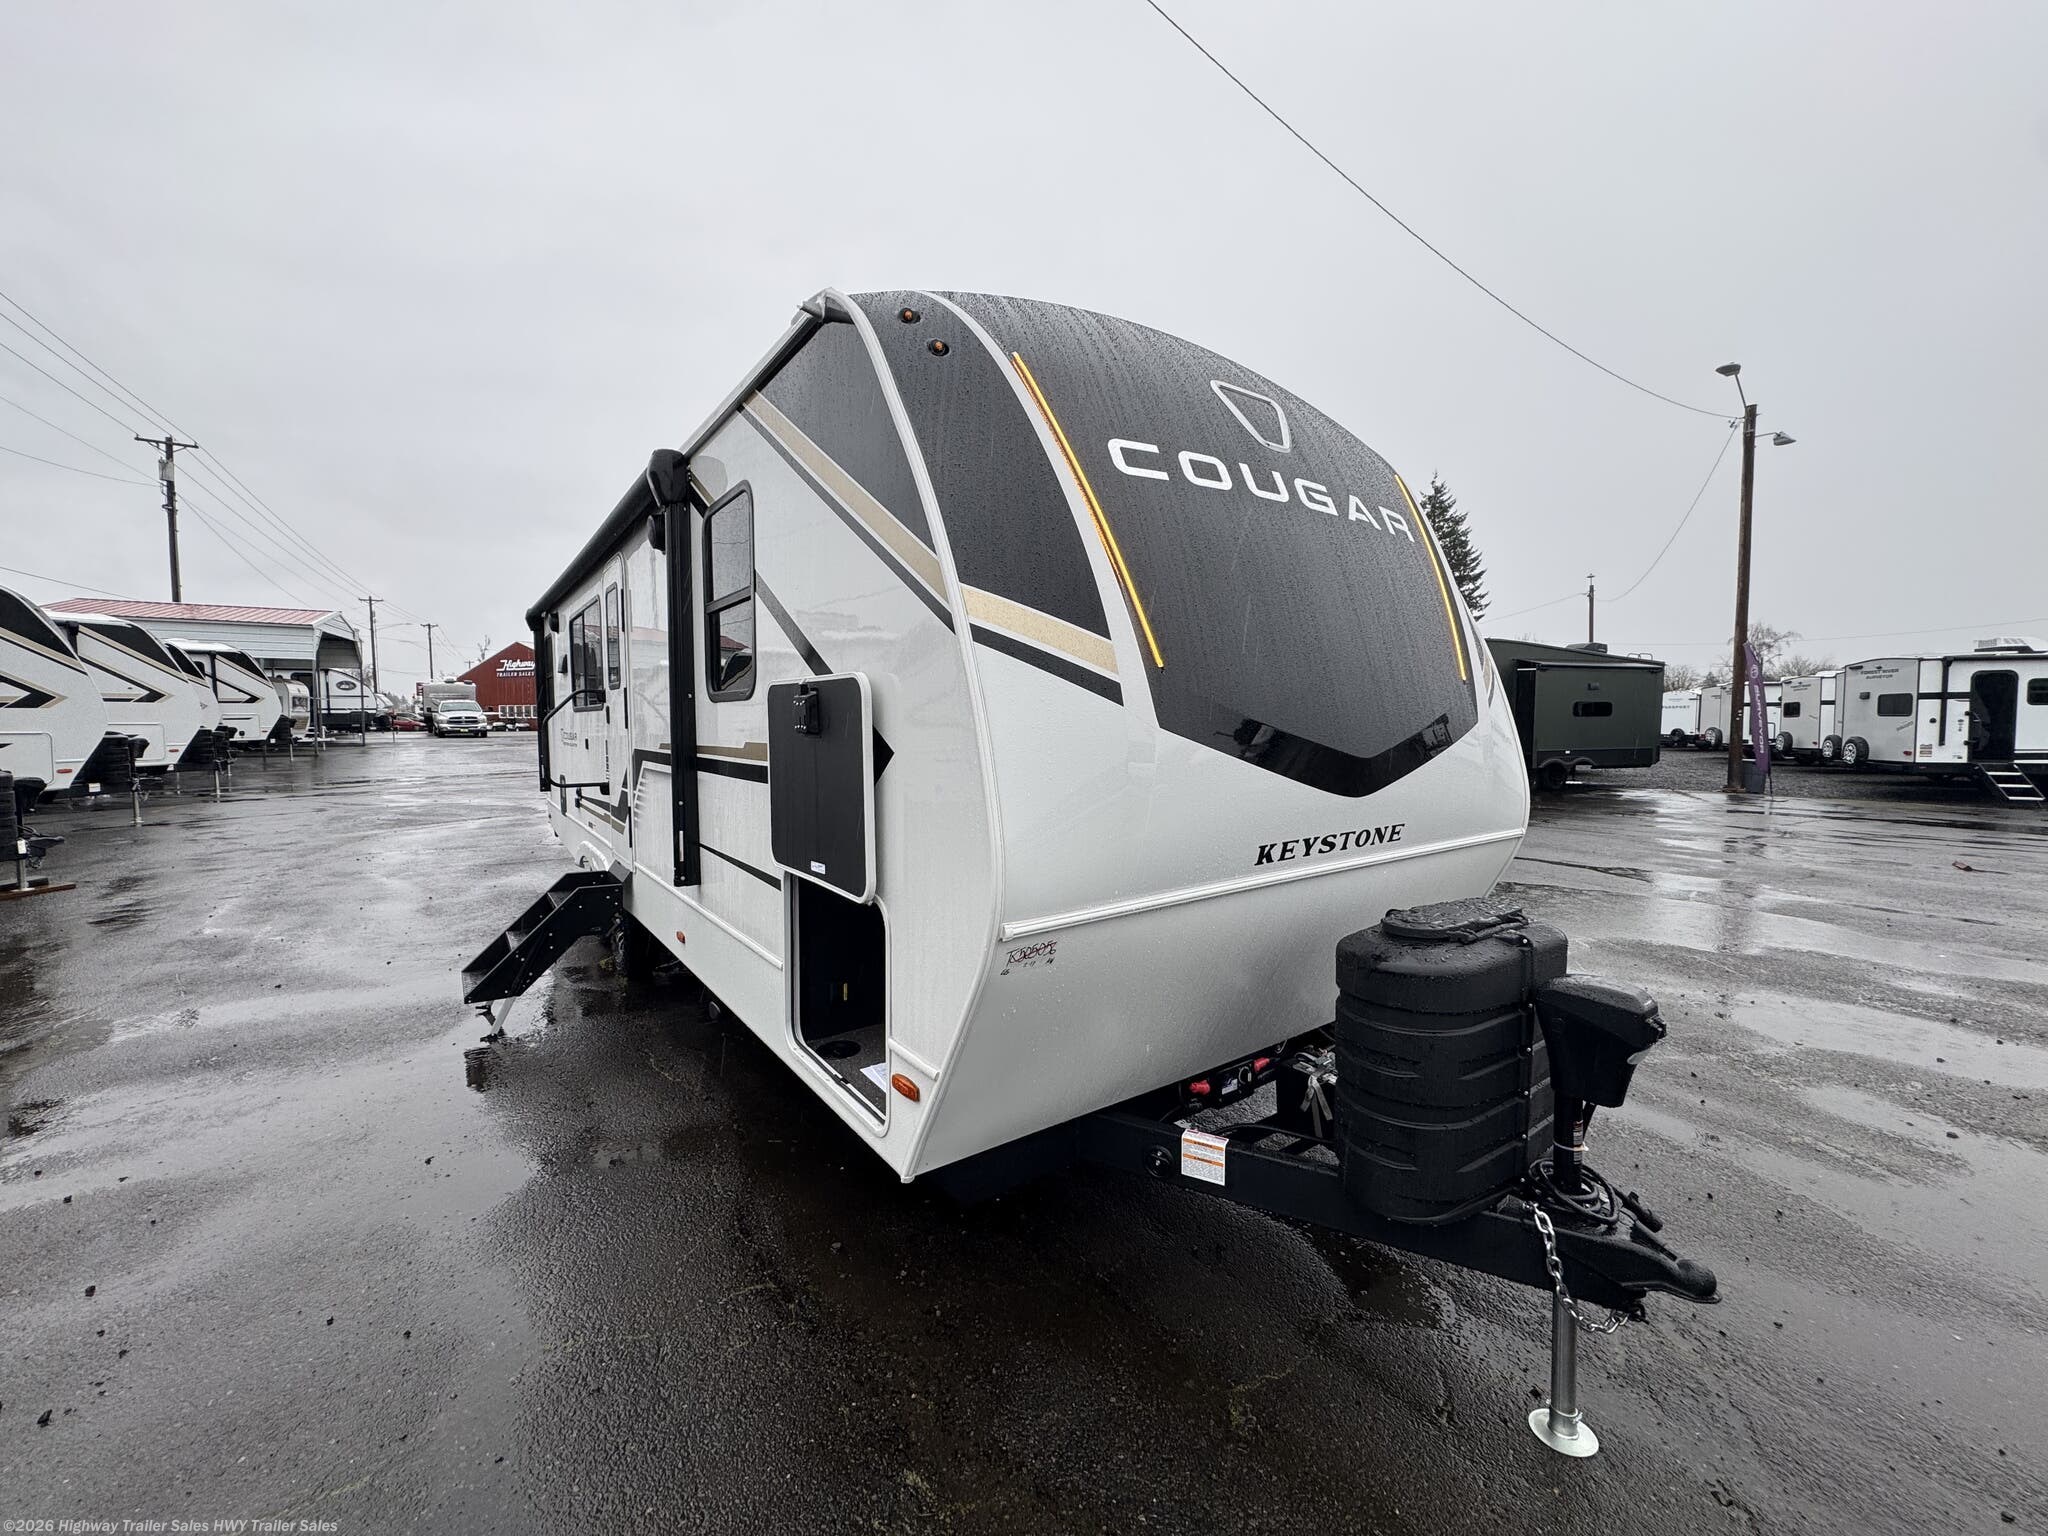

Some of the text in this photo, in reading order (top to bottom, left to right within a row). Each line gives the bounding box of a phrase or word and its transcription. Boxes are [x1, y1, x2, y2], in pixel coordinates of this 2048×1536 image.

[1107, 438, 1415, 543] COUGAR
[496, 659, 535, 671] Highway
[1753, 684, 1765, 754] SURVEYOR
[1254, 823, 1405, 866] KEYSTONE
